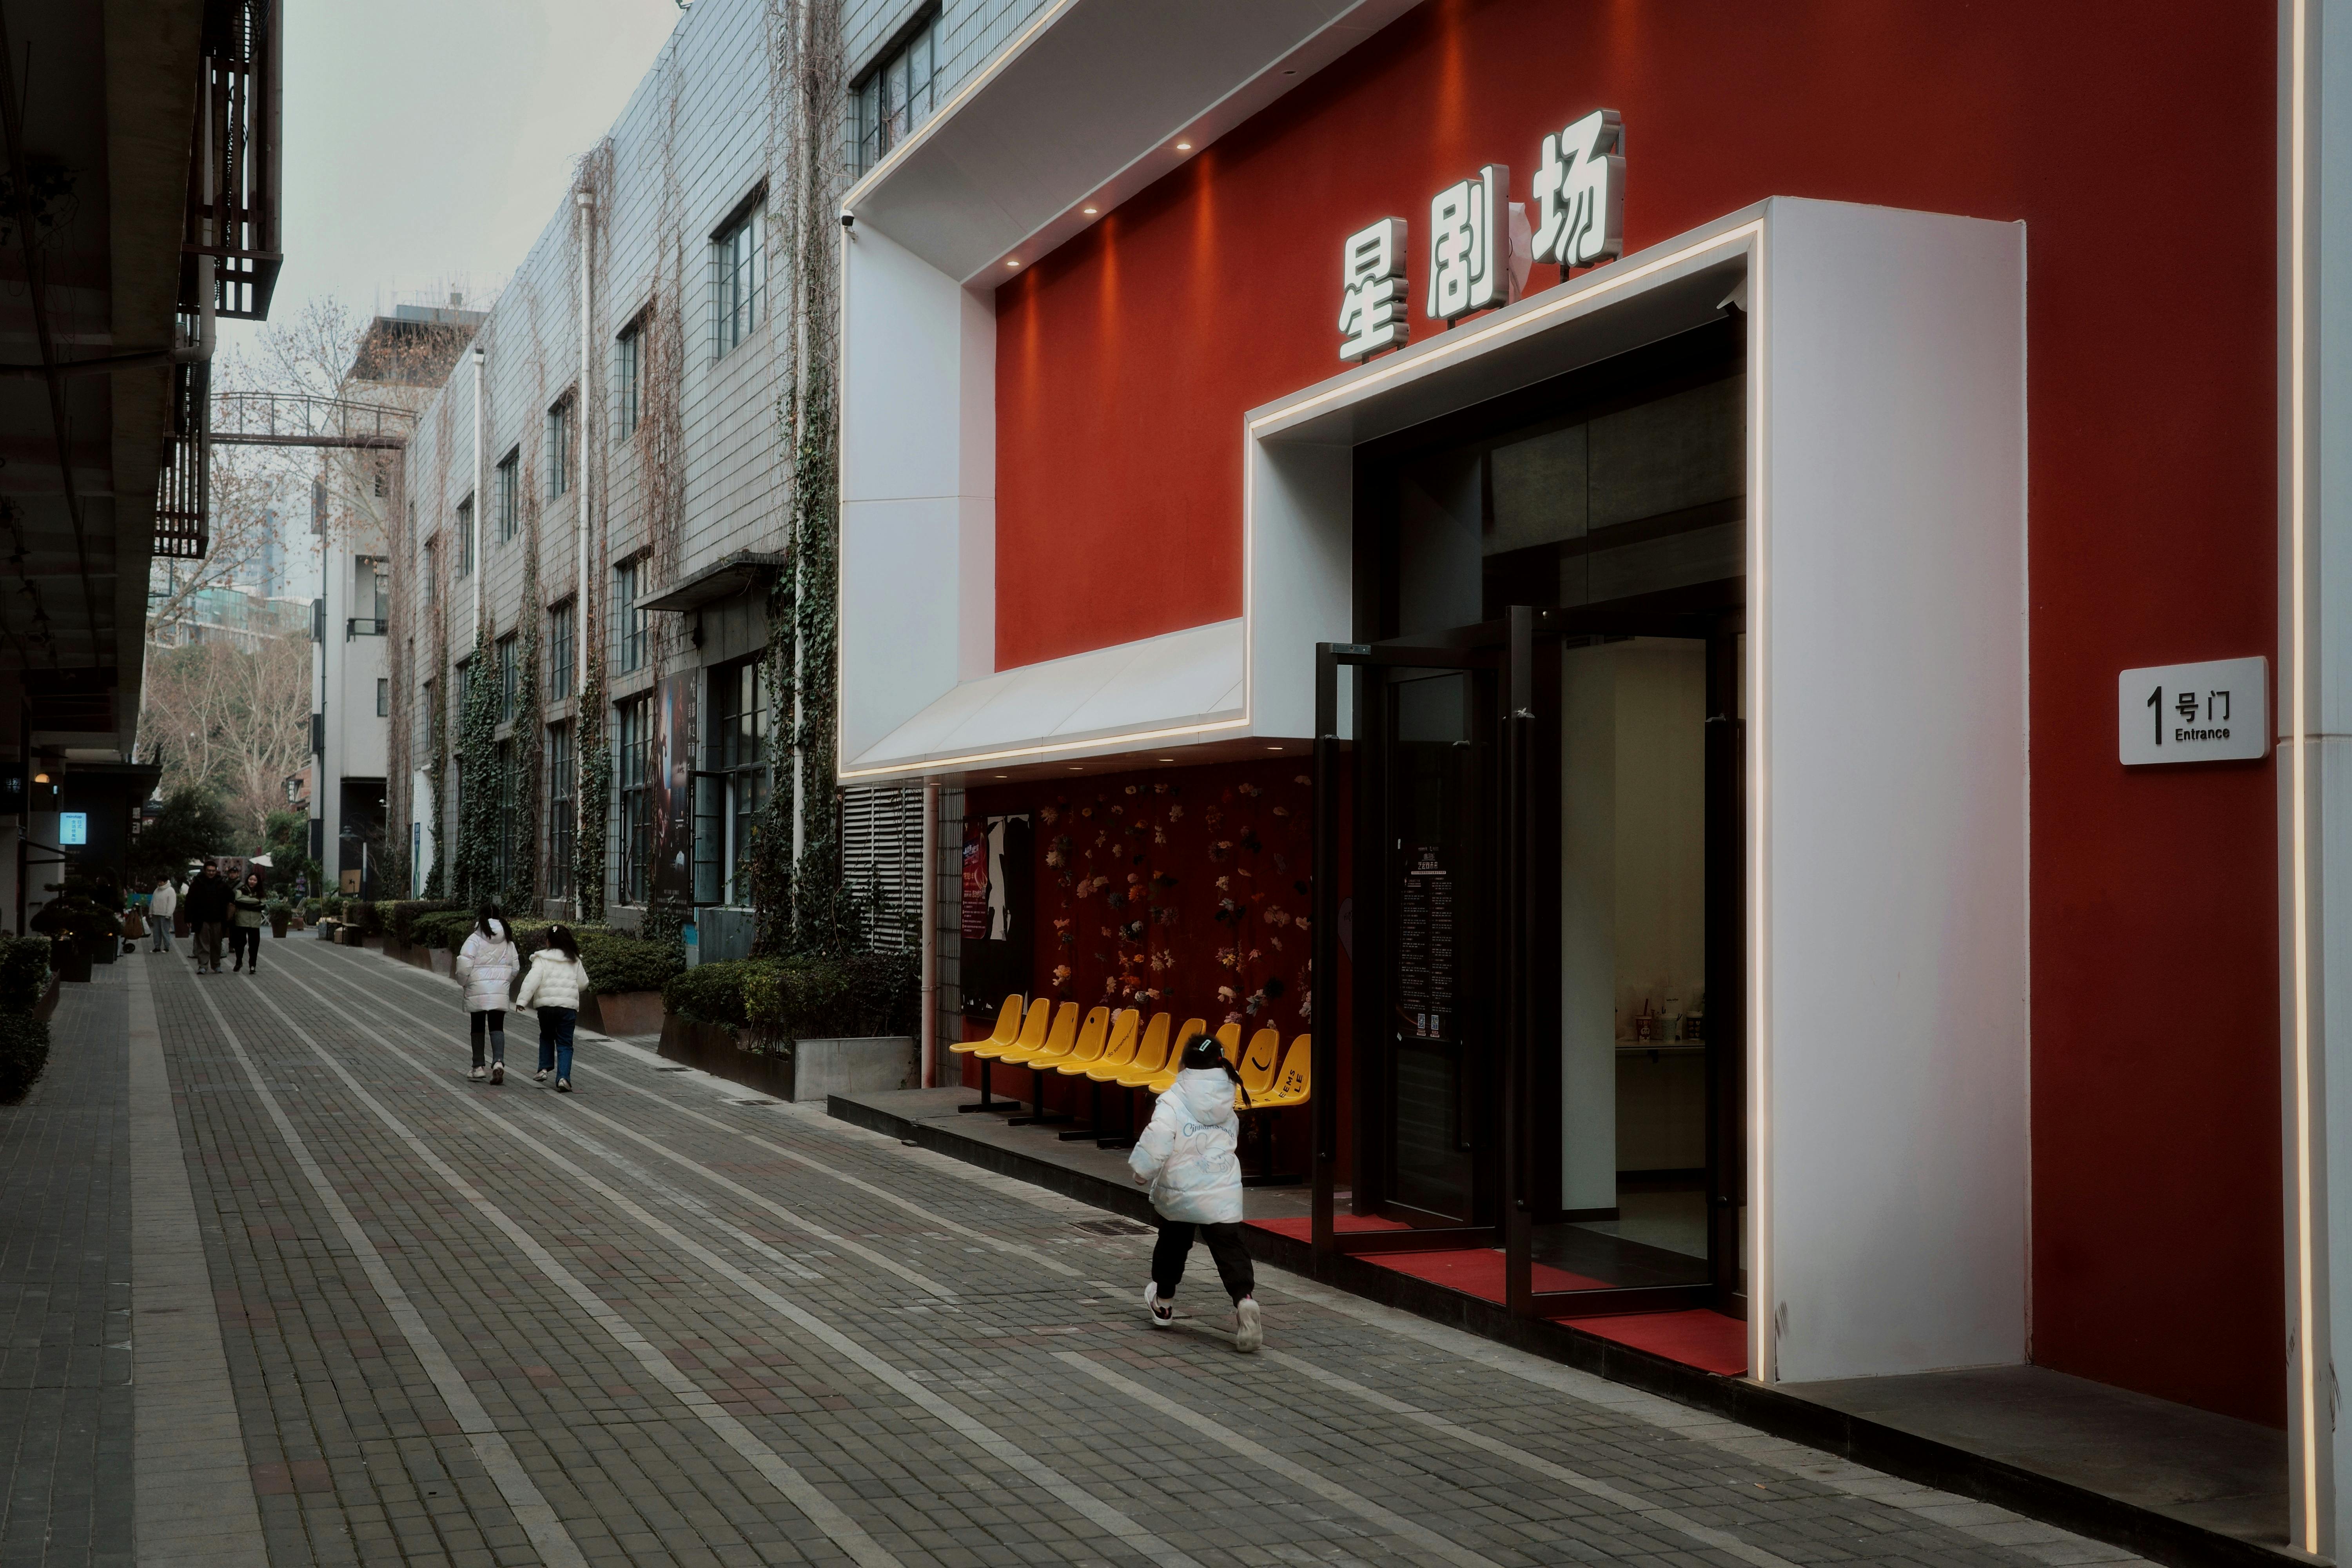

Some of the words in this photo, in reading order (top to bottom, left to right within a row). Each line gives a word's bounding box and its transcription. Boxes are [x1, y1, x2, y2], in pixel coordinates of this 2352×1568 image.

[1338, 109, 1612, 362] 星剧场
[2175, 728, 2230, 741] Entrance
[1114, 1033, 1129, 1053] something
